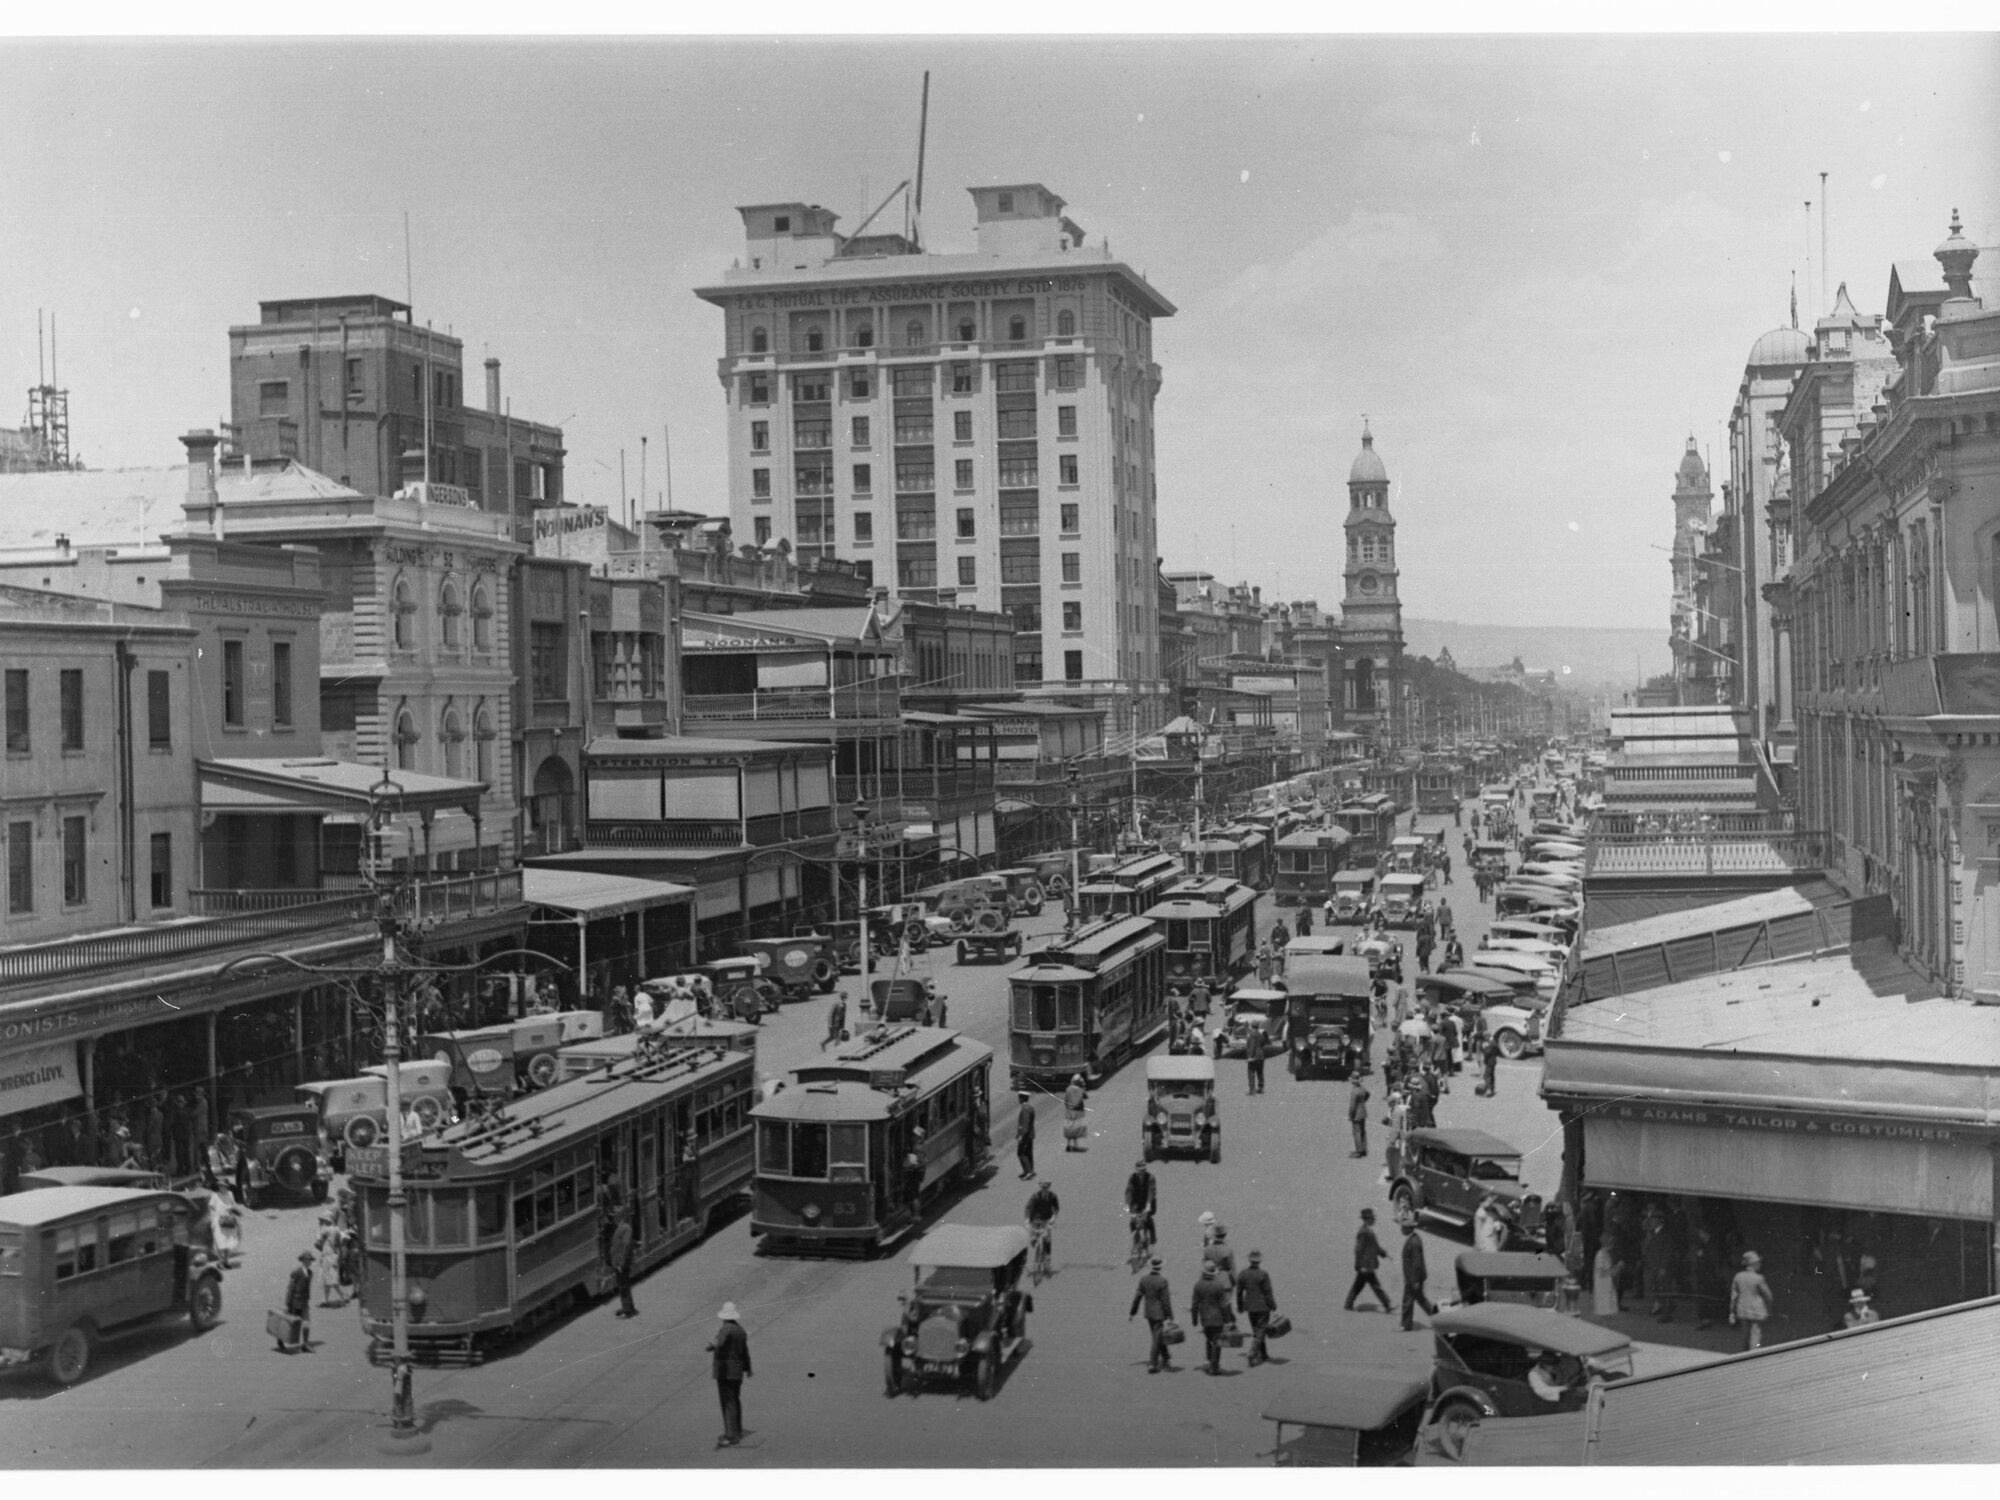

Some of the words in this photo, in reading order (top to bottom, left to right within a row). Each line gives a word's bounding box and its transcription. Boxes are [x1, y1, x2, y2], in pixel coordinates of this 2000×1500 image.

[773, 293, 825, 309] MUTUAL
[831, 290, 860, 305] LIFE
[868, 287, 945, 303] ASSURANCE
[197, 596, 217, 610] THE
[283, 603, 313, 616] HOUSE
[704, 637, 796, 648] NOONAN'S
[586, 758, 691, 767] AFTERNOON
[1059, 1043, 1080, 1055] 156
[1643, 1110, 1707, 1122] ADAMS
[1725, 1114, 1797, 1129] TAILOR
[1806, 1121, 1818, 1131] &
[1830, 1122, 1951, 1140] COSTUMIER
[349, 1150, 381, 1161] KEEP
[355, 1163, 383, 1175] LEFT
[833, 1201, 856, 1215] 83
